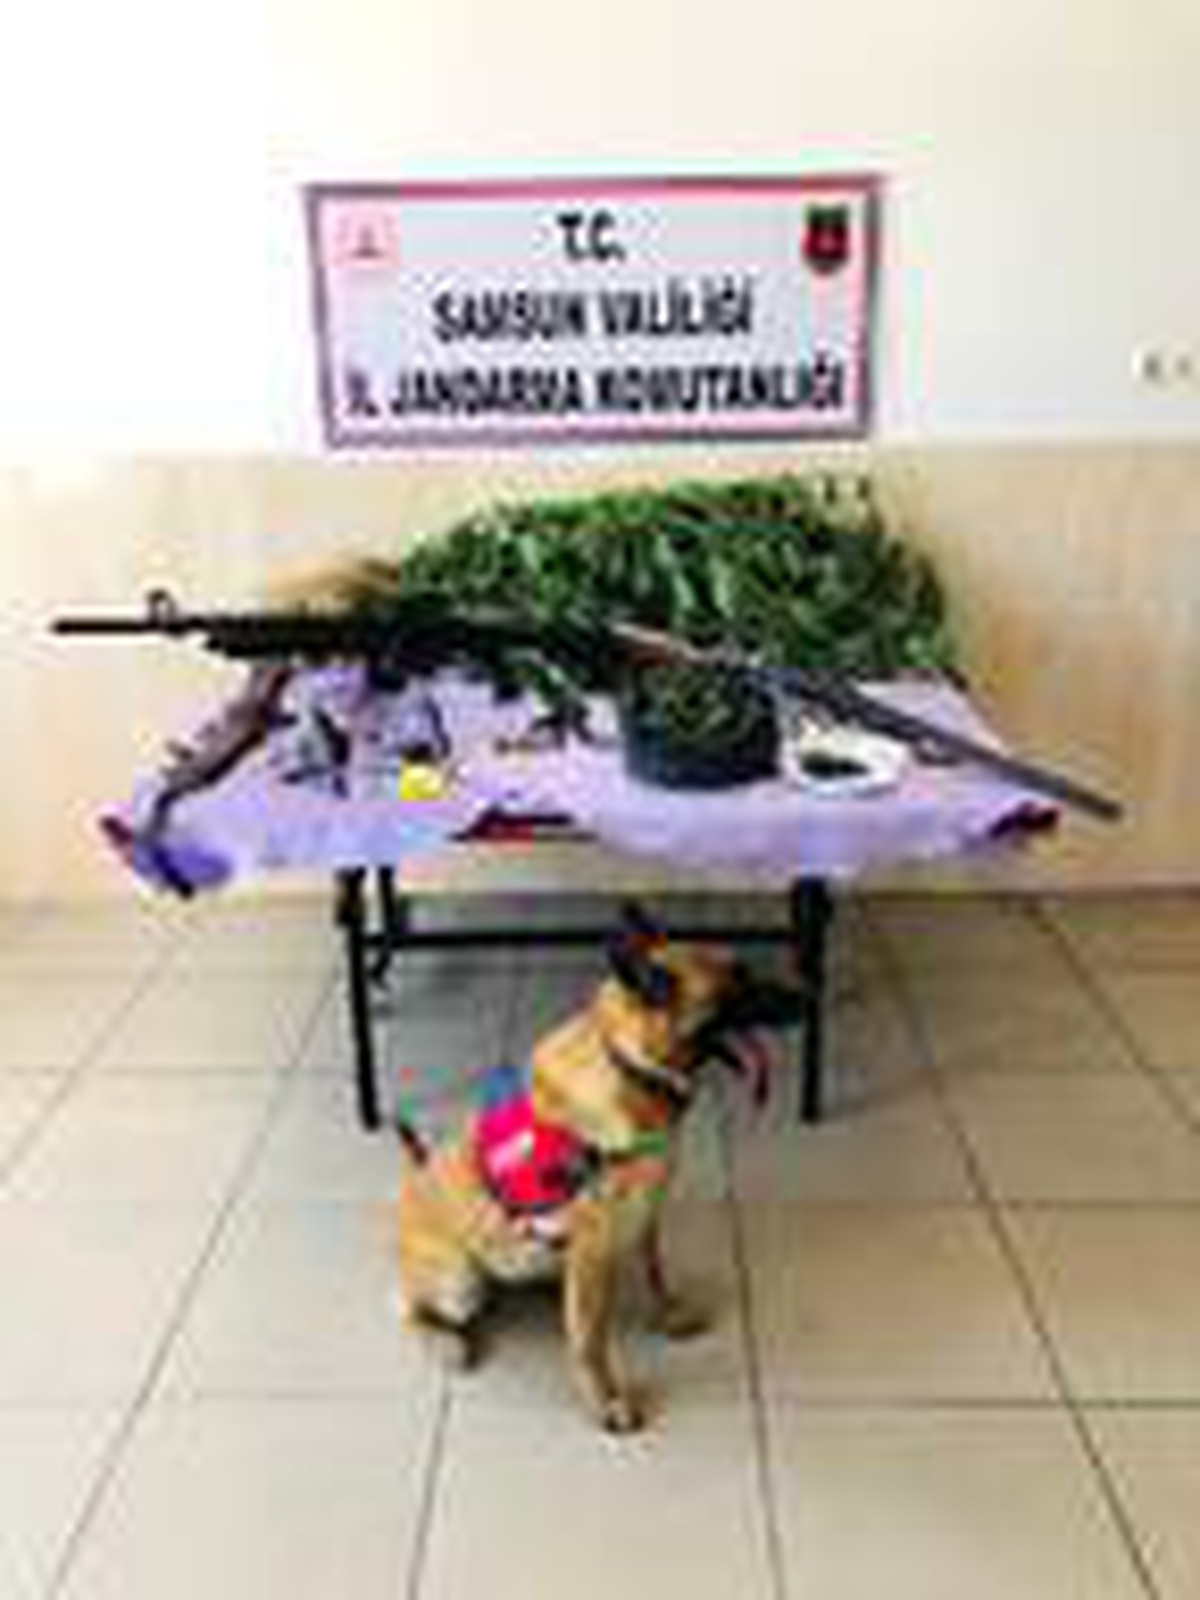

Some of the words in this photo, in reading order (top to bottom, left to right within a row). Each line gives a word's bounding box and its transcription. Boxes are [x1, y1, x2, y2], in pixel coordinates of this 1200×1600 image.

[555, 212, 626, 262] T.C.
[433, 291, 585, 342] SAMSUN
[391, 367, 582, 415] JANDARMA
